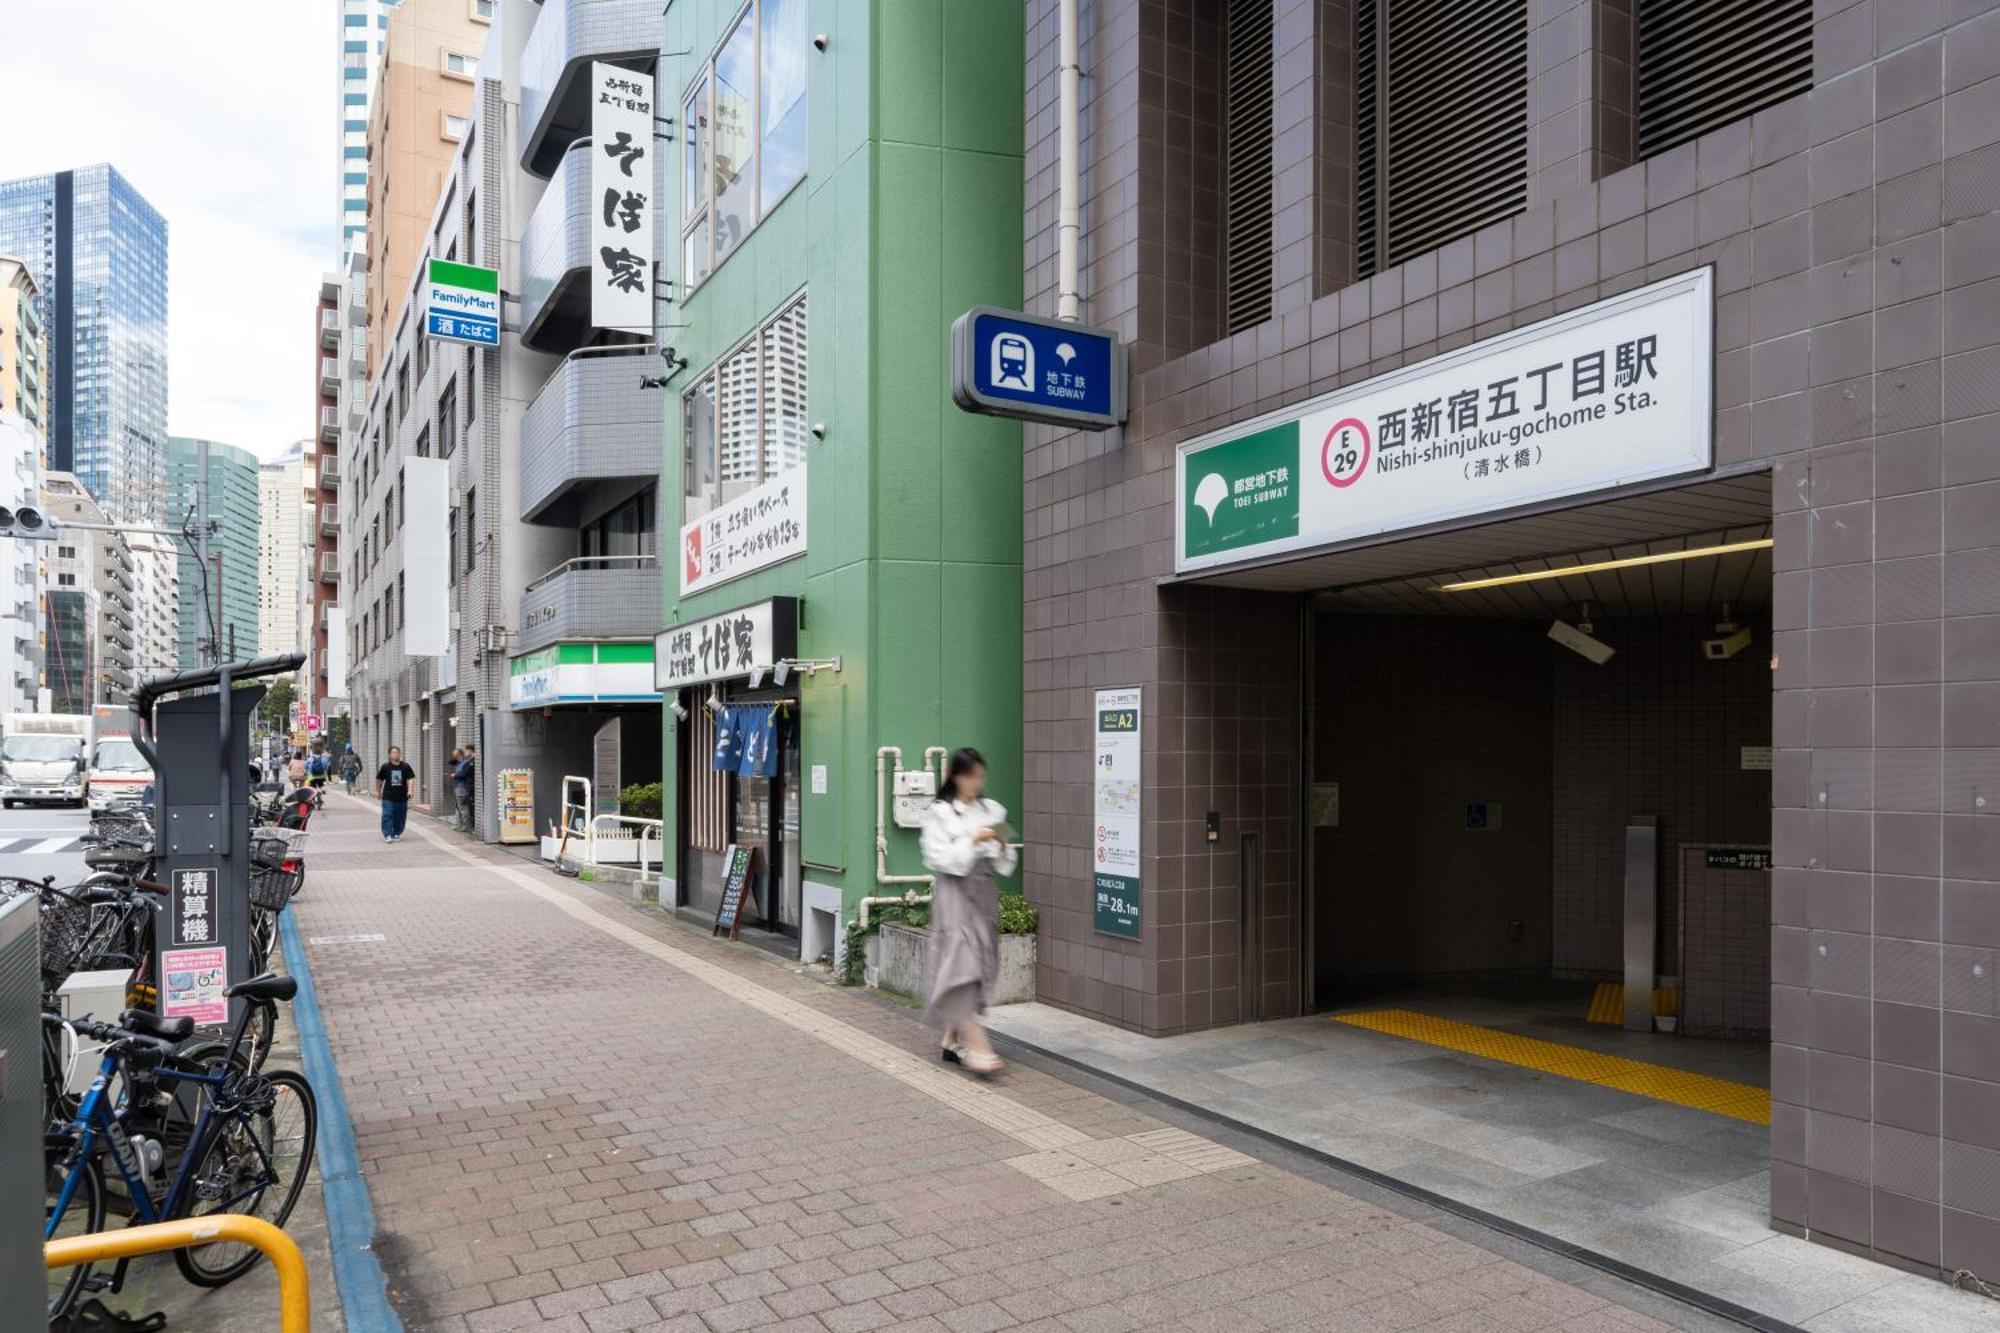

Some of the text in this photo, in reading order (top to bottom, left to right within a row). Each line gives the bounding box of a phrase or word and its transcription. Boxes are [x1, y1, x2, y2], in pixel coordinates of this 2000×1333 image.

[600, 131, 648, 294] そば家
[432, 289, 496, 310] FamilyMart
[437, 318, 494, 340] 酒 たばこ
[1046, 370, 1087, 389] 地下鉄
[1047, 384, 1086, 401] SUBWAY
[1377, 334, 1658, 453] 西新宿五丁目駅
[1341, 430, 1351, 449] E
[1376, 391, 1658, 474] Nishi-shinjuku-gochome Sta.
[1333, 450, 1359, 475] 29
[1234, 466, 1289, 494] 都営地下鉄
[1233, 485, 1289, 509] TOEI SUBWAY
[698, 612, 754, 676] そば家
[1118, 712, 1134, 729] A2
[181, 871, 209, 942] 精算機
[1110, 897, 1139, 916] 28.1m
